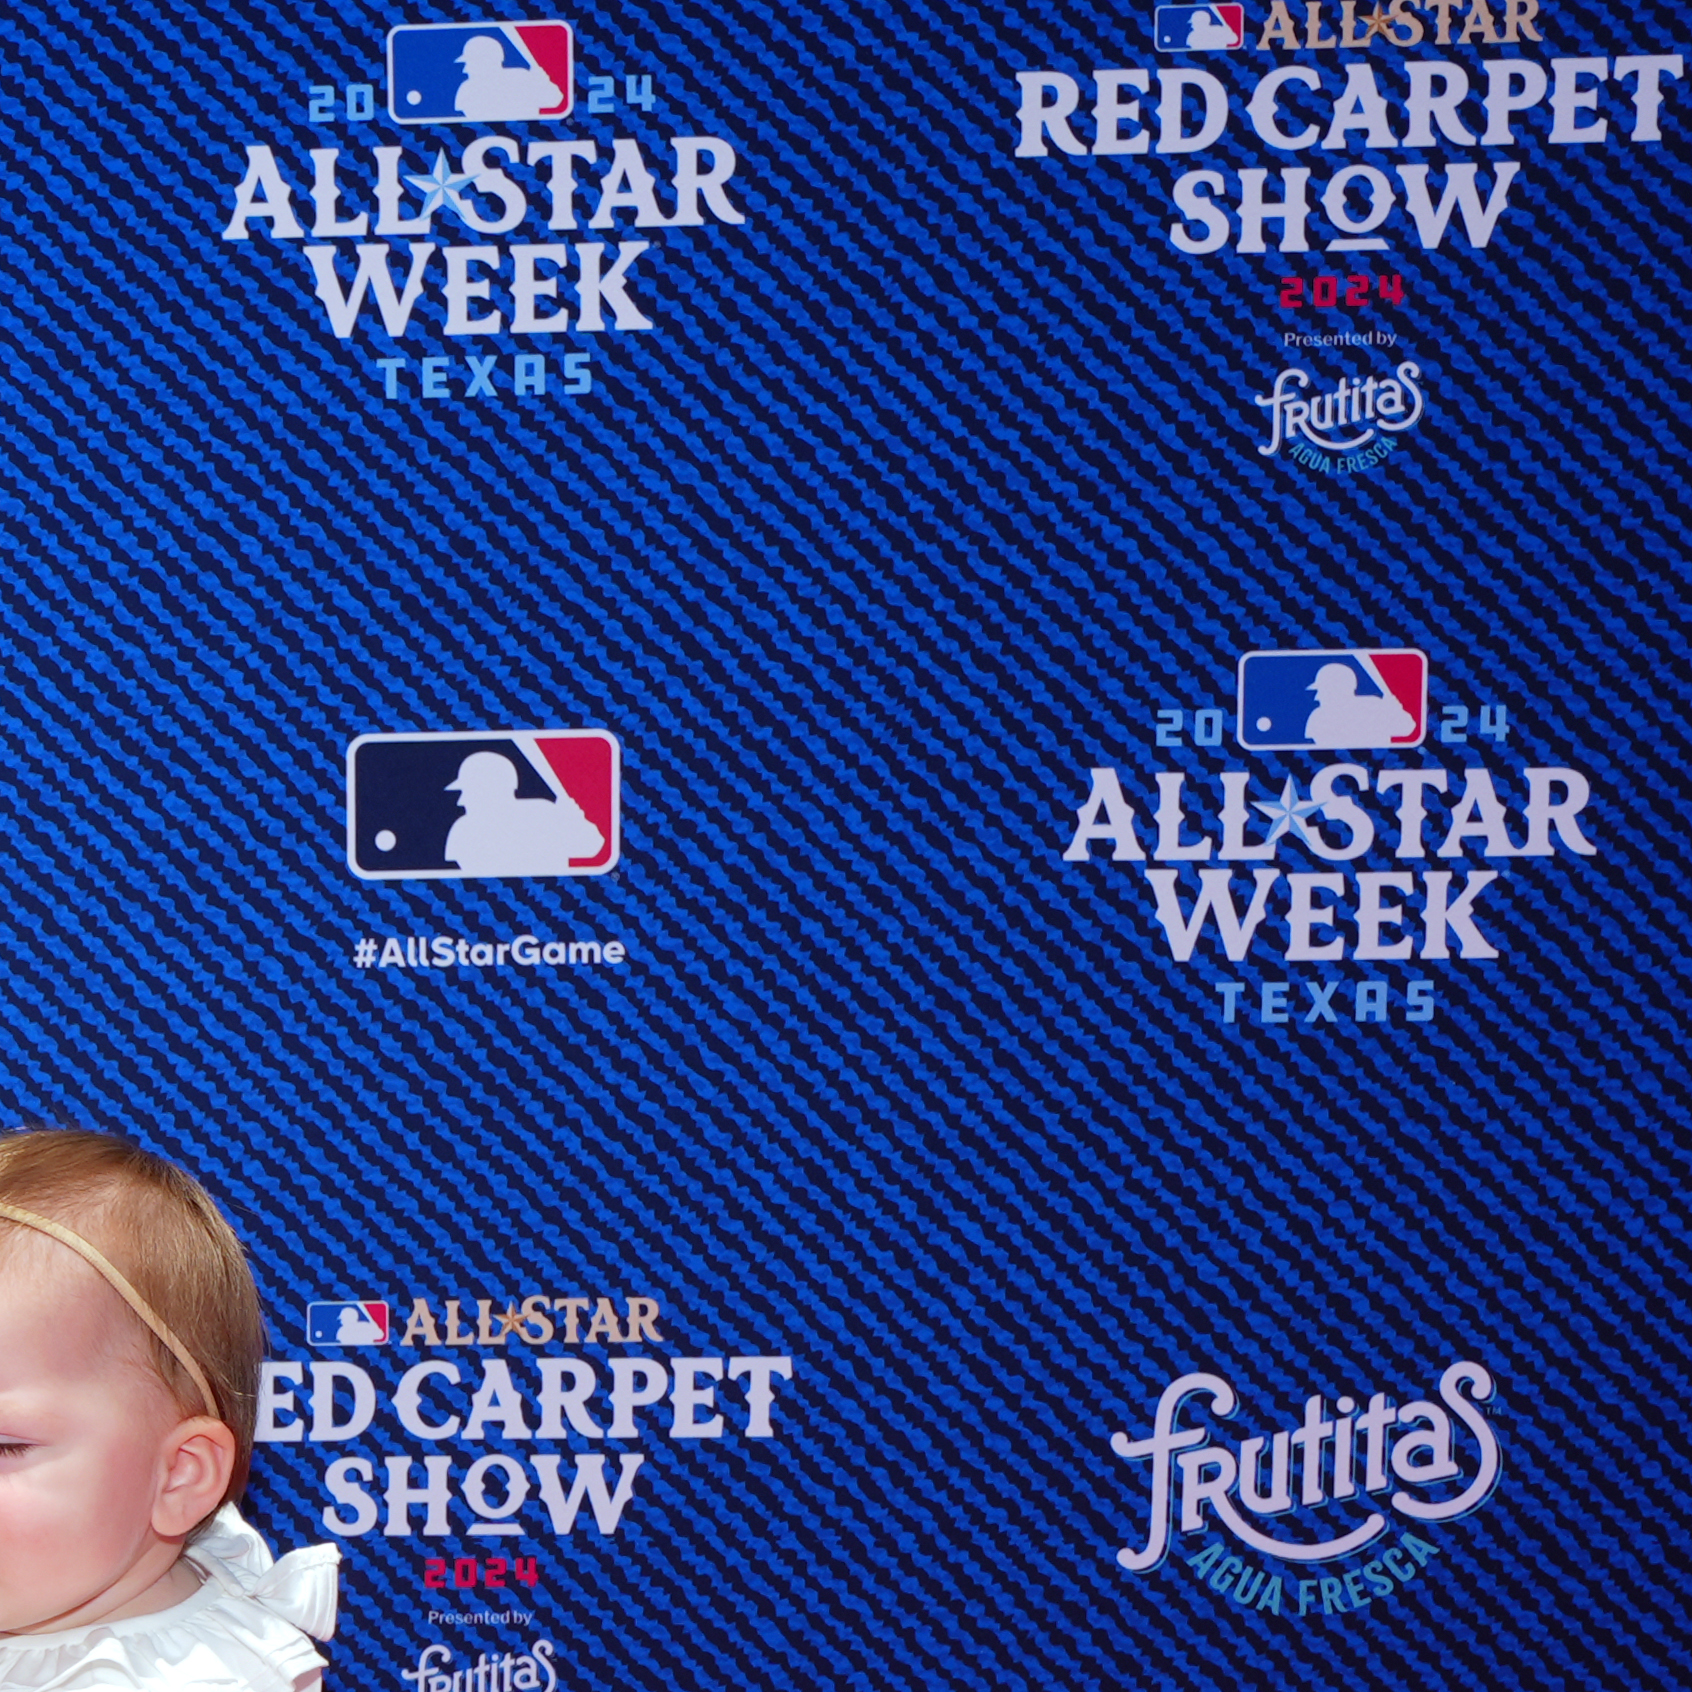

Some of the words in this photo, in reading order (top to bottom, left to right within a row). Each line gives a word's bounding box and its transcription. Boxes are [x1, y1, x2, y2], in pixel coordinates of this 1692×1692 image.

[309, 84, 374, 122] 20
[588, 75, 655, 113] 24
[1015, 68, 1228, 157] RED
[1246, 55, 1683, 150] CARPET
[1170, 162, 1520, 254] SHOW
[303, 240, 654, 339] WEEK
[1280, 274, 1404, 308] 2024
[1284, 331, 1372, 347] Presented
[1377, 331, 1397, 348] by
[377, 353, 591, 399] TEXAS
[1289, 443, 1331, 474] AGUA
[1337, 436, 1399, 475] FRESCA
[1156, 709, 1222, 746] 20
[1441, 705, 1509, 742] 24
[1145, 868, 1499, 961] WEEK
[353, 935, 625, 967] #AllStarGame
[1216, 980, 1434, 1022] TEXAS
[392, 1356, 792, 1439] CARPET
[323, 1454, 644, 1536] SHOW
[424, 1557, 539, 1588] 2024
[1186, 1542, 1283, 1617] AGUA
[1298, 1531, 1441, 1618] FRESCA
[428, 1610, 510, 1625] Presented
[514, 1610, 533, 1626] by
